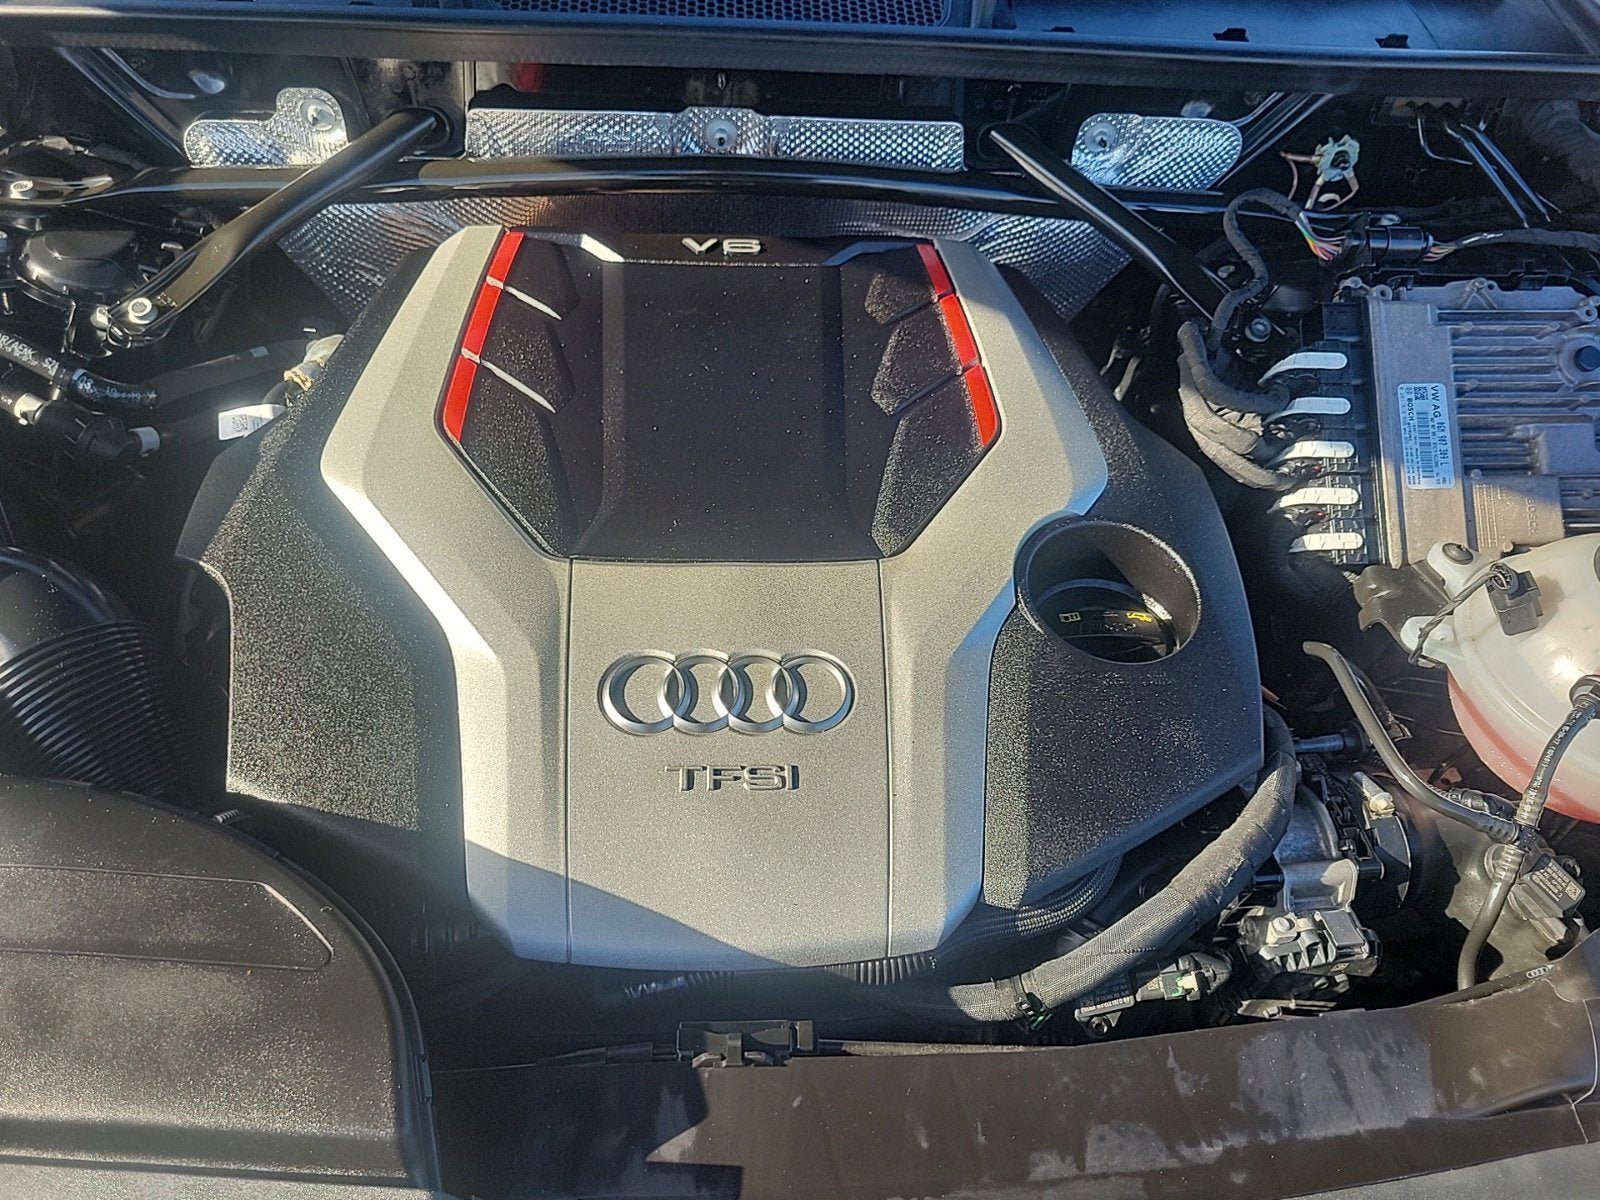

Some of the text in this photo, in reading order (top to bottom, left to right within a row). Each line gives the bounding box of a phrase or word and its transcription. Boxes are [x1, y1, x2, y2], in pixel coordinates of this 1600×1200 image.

[681, 237, 761, 256] V6
[1430, 385, 1440, 401] VW
[1406, 398, 1415, 421] BOSCH
[1432, 404, 1442, 418] AG
[1526, 498, 1539, 536] BOSCH
[664, 764, 800, 792] TFSI
